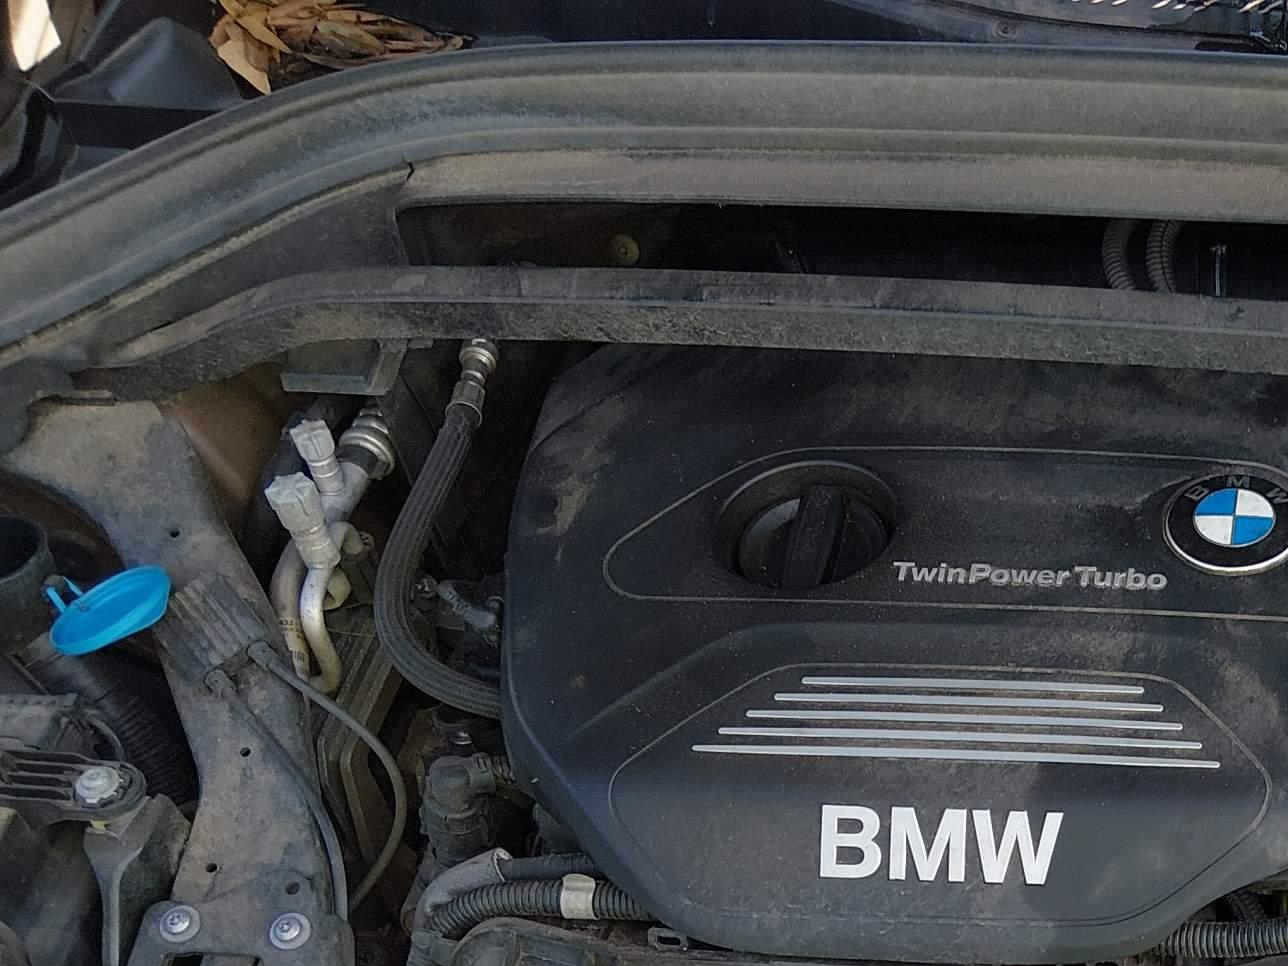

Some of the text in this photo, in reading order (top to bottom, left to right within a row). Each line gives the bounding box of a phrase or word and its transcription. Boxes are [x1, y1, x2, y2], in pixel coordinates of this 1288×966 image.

[892, 560, 1168, 591] TwinPower Turbo
[820, 804, 1064, 885] BMW
